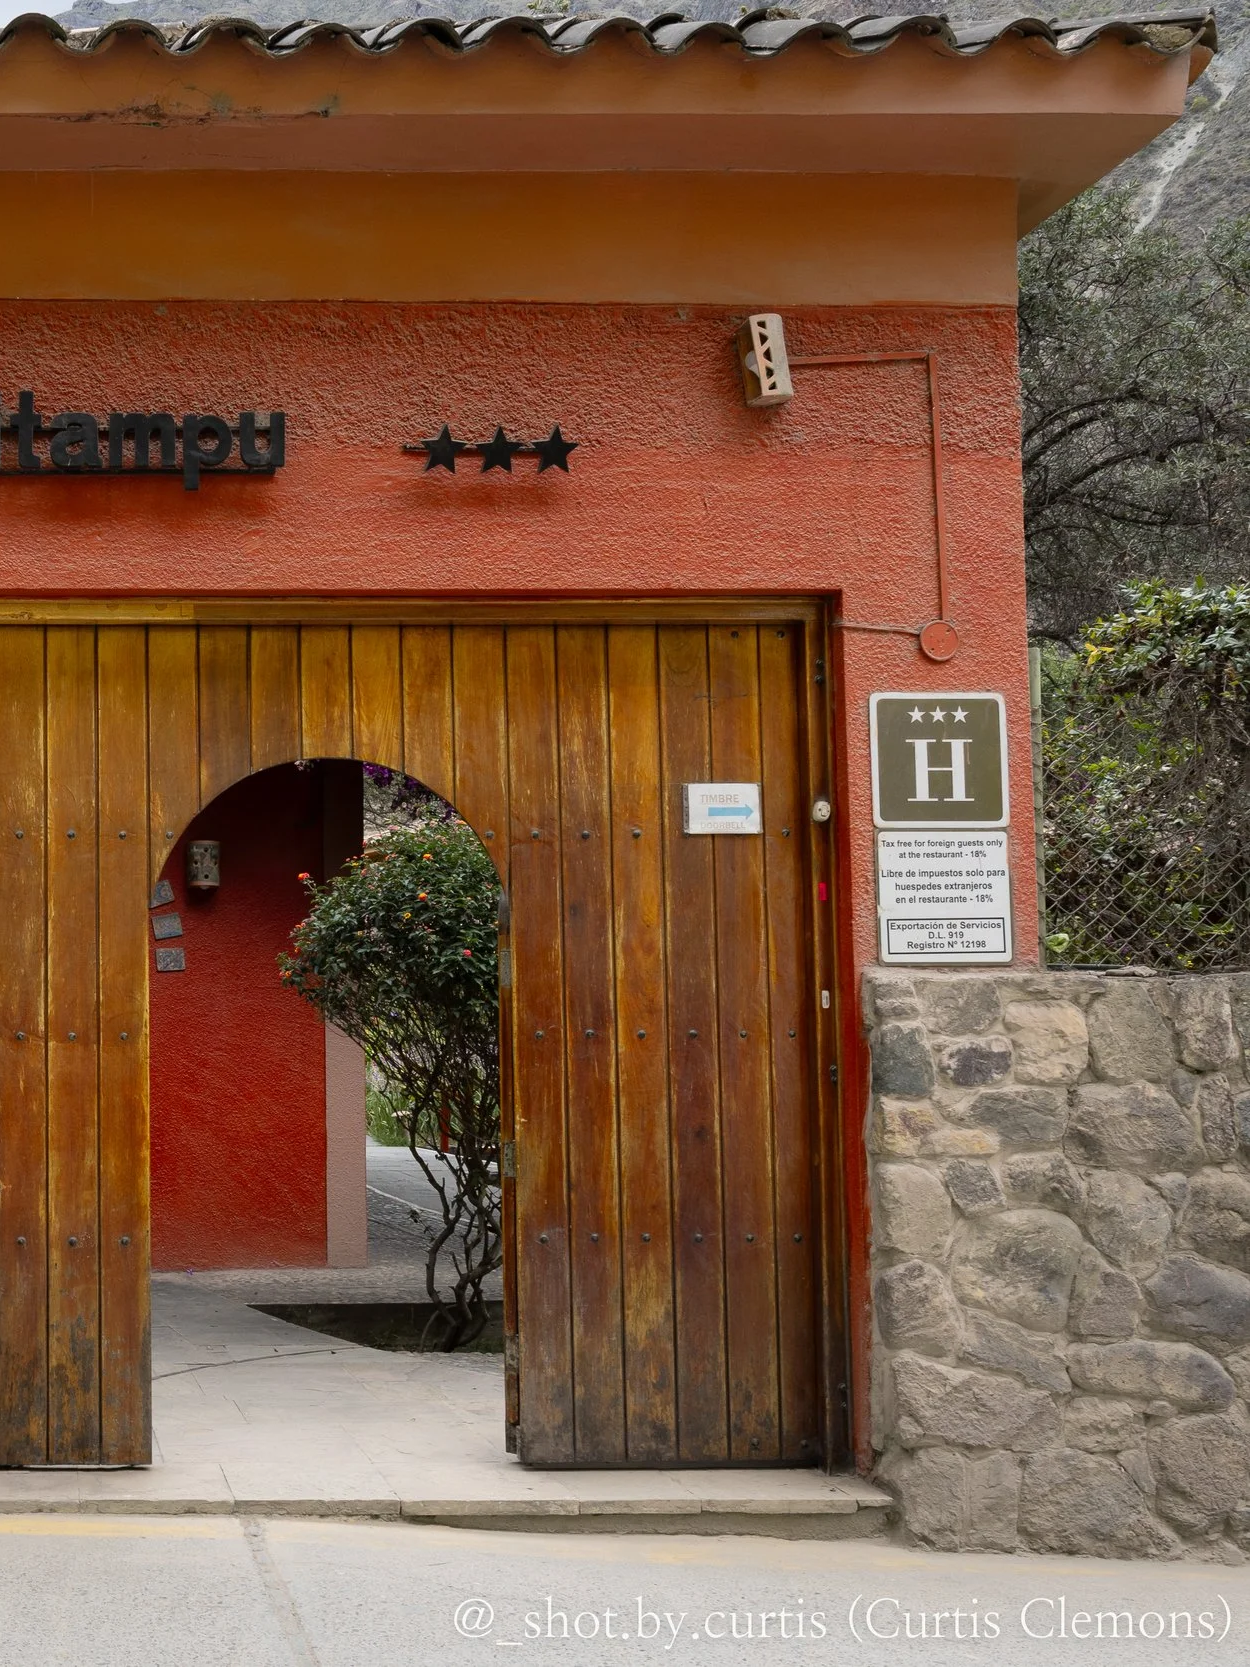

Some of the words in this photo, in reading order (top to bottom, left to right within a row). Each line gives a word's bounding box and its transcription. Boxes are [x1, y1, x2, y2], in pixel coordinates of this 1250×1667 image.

[905, 738, 975, 802] H
[700, 794, 740, 804] TIMBRE
[700, 821, 747, 830] DOORBELL
[881, 840, 895, 848] Tax
[927, 840, 956, 849] foreign
[957, 840, 984, 849] guests
[985, 839, 1003, 848] only
[908, 851, 921, 859] the
[922, 851, 963, 859] restaurant
[970, 850, 987, 858] 18%
[881, 869, 904, 878] Libre
[905, 869, 917, 877] de
[918, 869, 963, 880] impuestos
[965, 869, 985, 877] solo
[986, 869, 1006, 879] para
[895, 882, 942, 893] huespedes
[944, 882, 993, 892] extranjeros
[908, 895, 916, 904] el
[918, 895, 968, 903] restaurante
[975, 894, 993, 903] 18%
[890, 921, 944, 931] Exportación
[946, 921, 958, 929] de
[960, 921, 1002, 929] Servicios
[948, 931, 964, 939] 919
[907, 941, 945, 951] Registro
[961, 940, 987, 948] 12198
